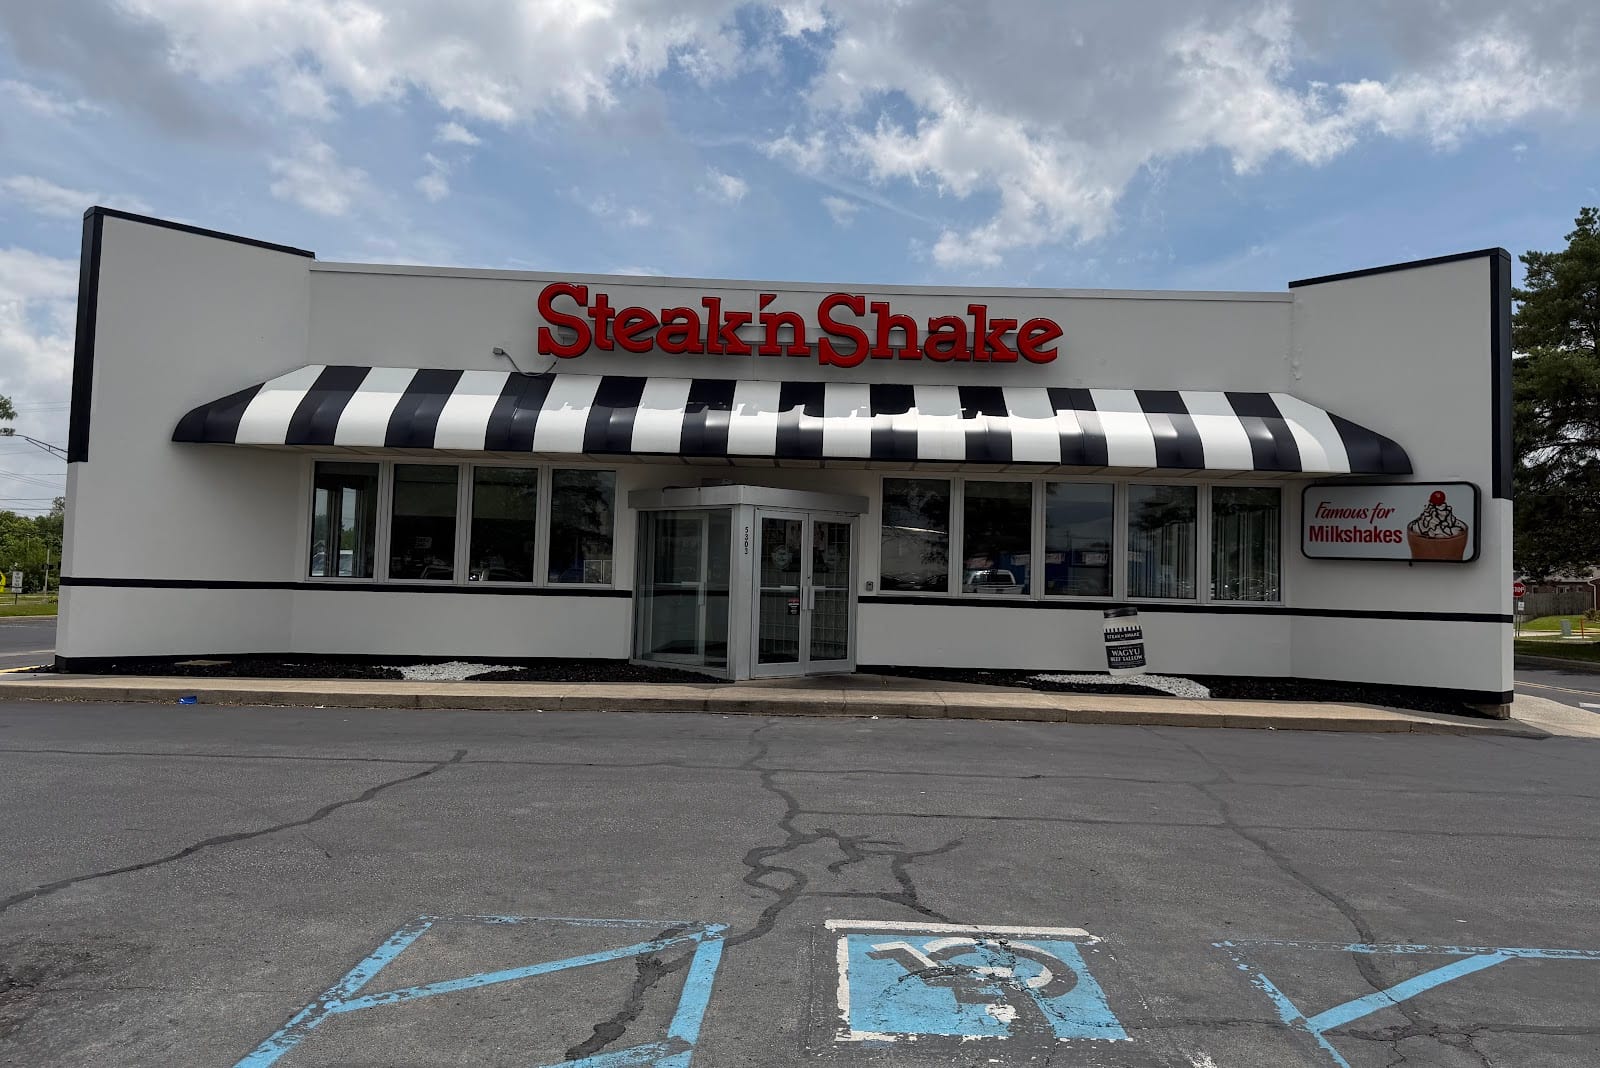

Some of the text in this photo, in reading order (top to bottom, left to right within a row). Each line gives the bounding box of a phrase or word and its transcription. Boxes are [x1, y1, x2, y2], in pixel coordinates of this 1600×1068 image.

[537, 281, 753, 359] Steak
[817, 292, 1064, 367] Shake
[1315, 502, 1395, 524] Famous for
[1309, 526, 1403, 543] Milkshakes
[1112, 649, 1140, 657] WAGYU
